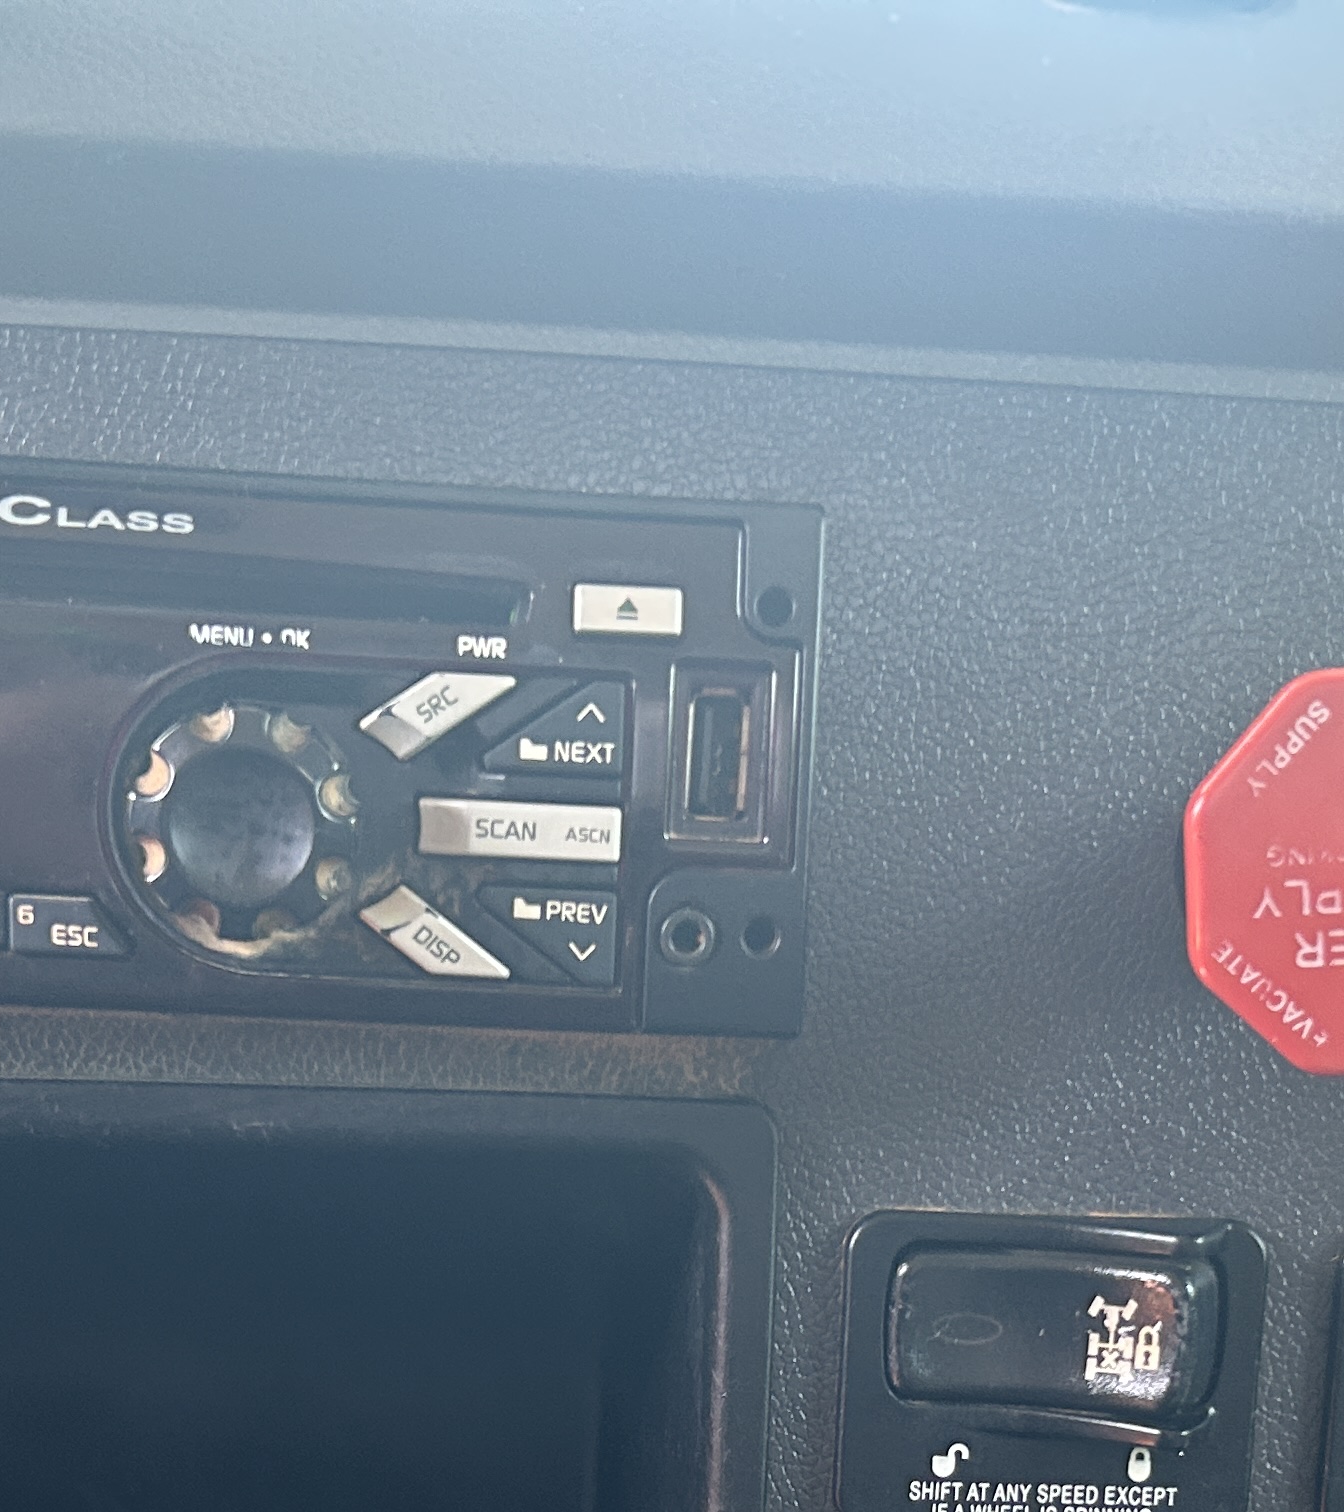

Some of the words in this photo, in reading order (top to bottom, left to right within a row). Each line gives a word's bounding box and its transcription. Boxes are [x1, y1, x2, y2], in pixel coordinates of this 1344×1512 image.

[189, 623, 254, 648] MENU
[457, 635, 508, 660] PWR
[416, 684, 459, 724] SRC
[554, 741, 615, 765] NEXT
[1247, 699, 1332, 798] SUPPLY
[475, 818, 537, 842] SCAN
[565, 827, 611, 845] ASCN
[17, 905, 35, 925] 6
[51, 924, 100, 949] ESC
[545, 901, 608, 926] PREV
[413, 923, 461, 965] DISP
[909, 1480, 964, 1502] SHIFT
[967, 1482, 990, 1502] AT
[993, 1483, 1032, 1502] ANY
[1036, 1484, 1099, 1505] SPEED
[1104, 1486, 1178, 1507] EXCEPT
